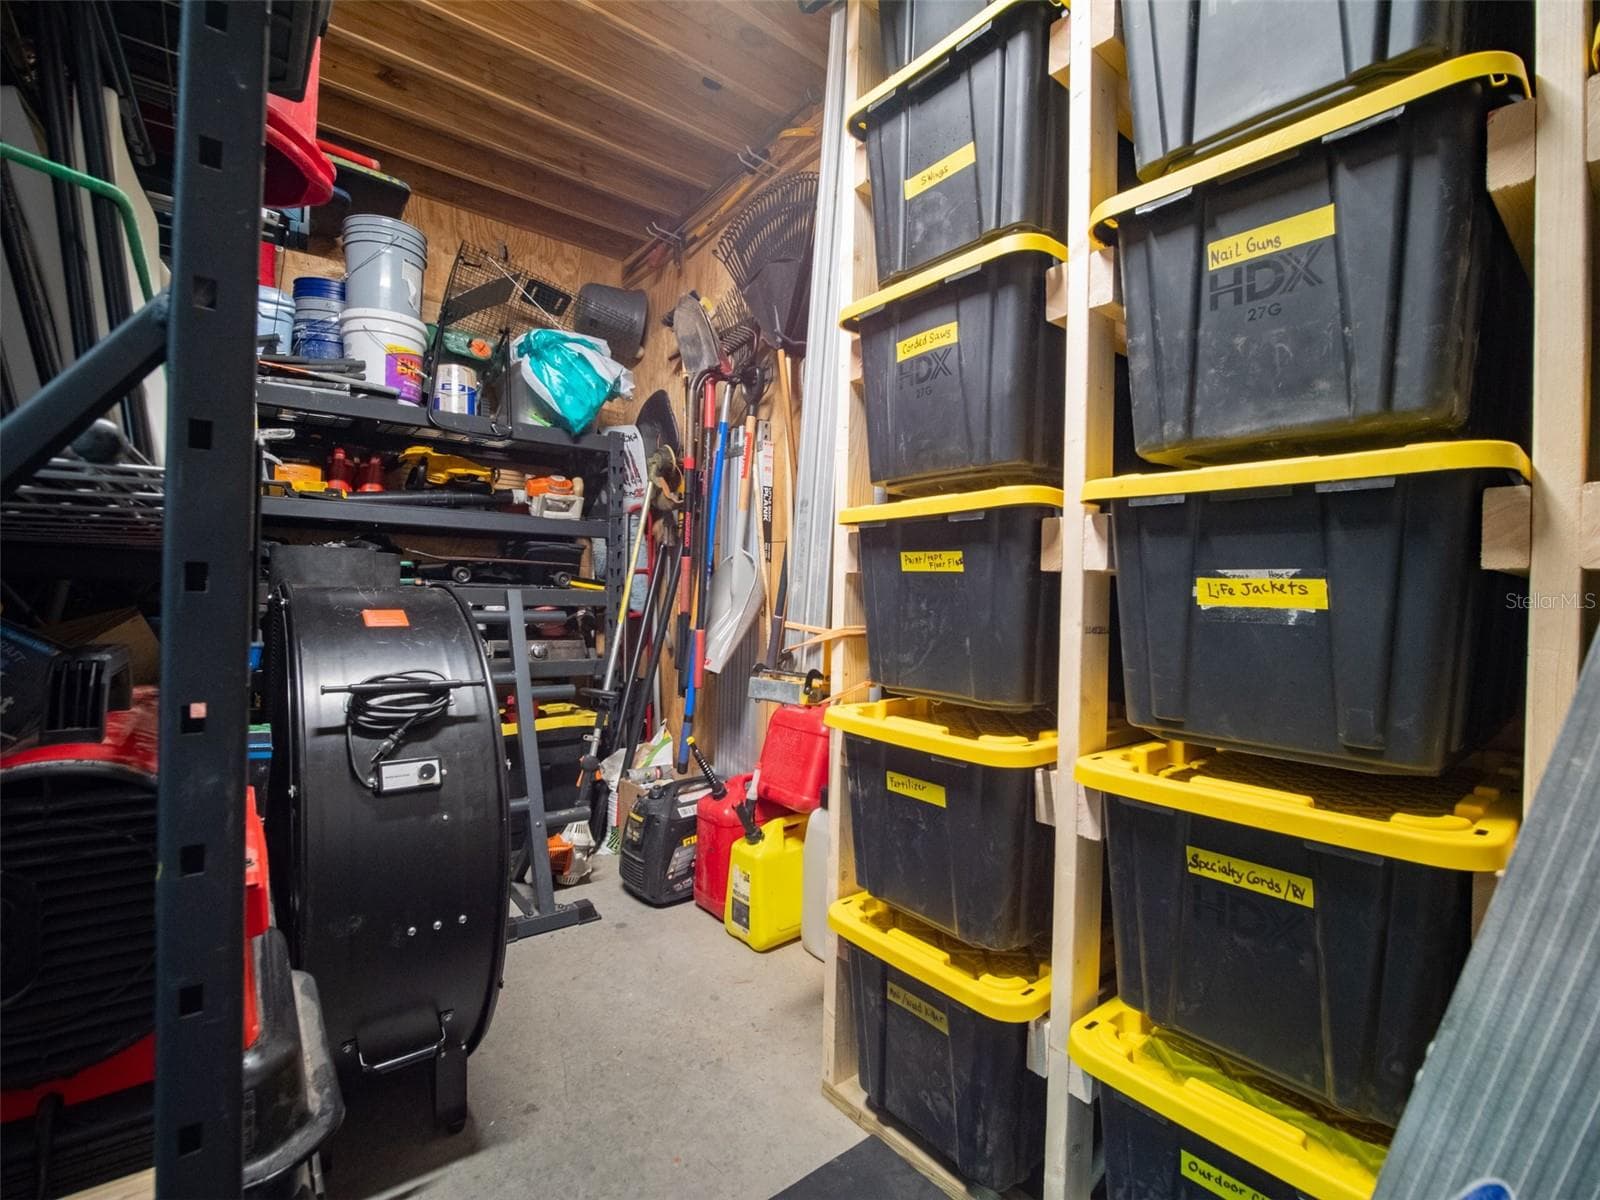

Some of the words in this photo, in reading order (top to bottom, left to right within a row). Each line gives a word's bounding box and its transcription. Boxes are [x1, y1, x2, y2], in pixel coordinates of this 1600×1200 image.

[1246, 236, 1282, 254] Guns
[1208, 242, 1325, 312] HDX
[1246, 302, 1284, 322] 27G
[898, 347, 953, 391] HDX
[1240, 581, 1310, 598] Jackets
[1188, 853, 1244, 885] Specialty
[1187, 1159, 1247, 1197] Outdoor
